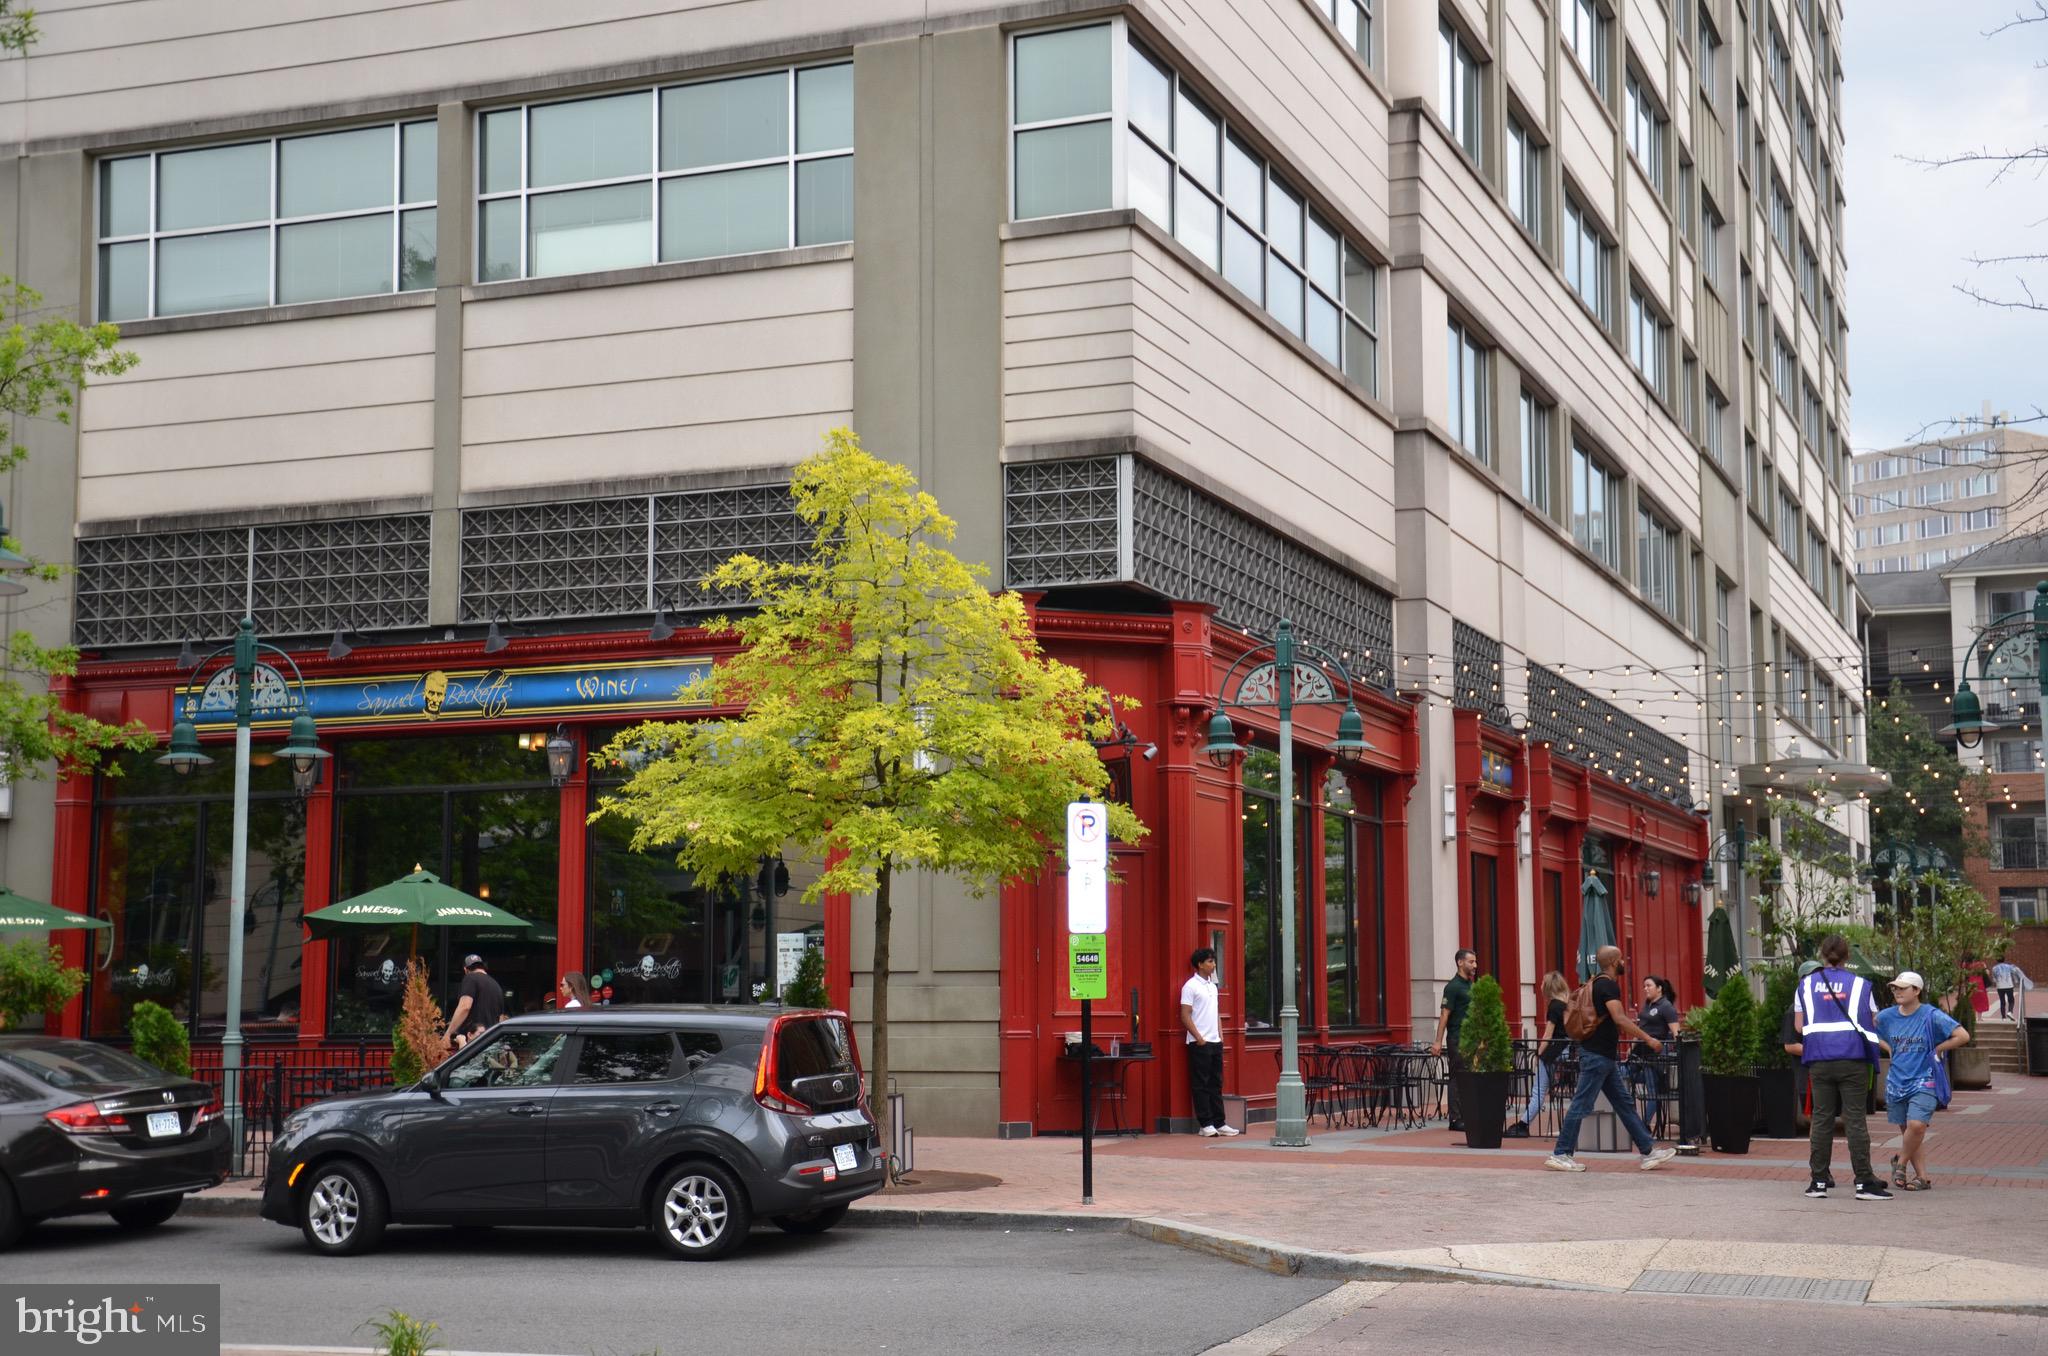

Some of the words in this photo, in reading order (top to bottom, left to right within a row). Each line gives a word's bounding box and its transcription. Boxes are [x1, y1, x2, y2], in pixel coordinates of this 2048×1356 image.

[357, 671, 430, 716] Samuel
[446, 669, 513, 718] Beckett's
[576, 676, 638, 699] WINES
[342, 905, 407, 916] JAMESON
[435, 906, 493, 918] JAMESON
